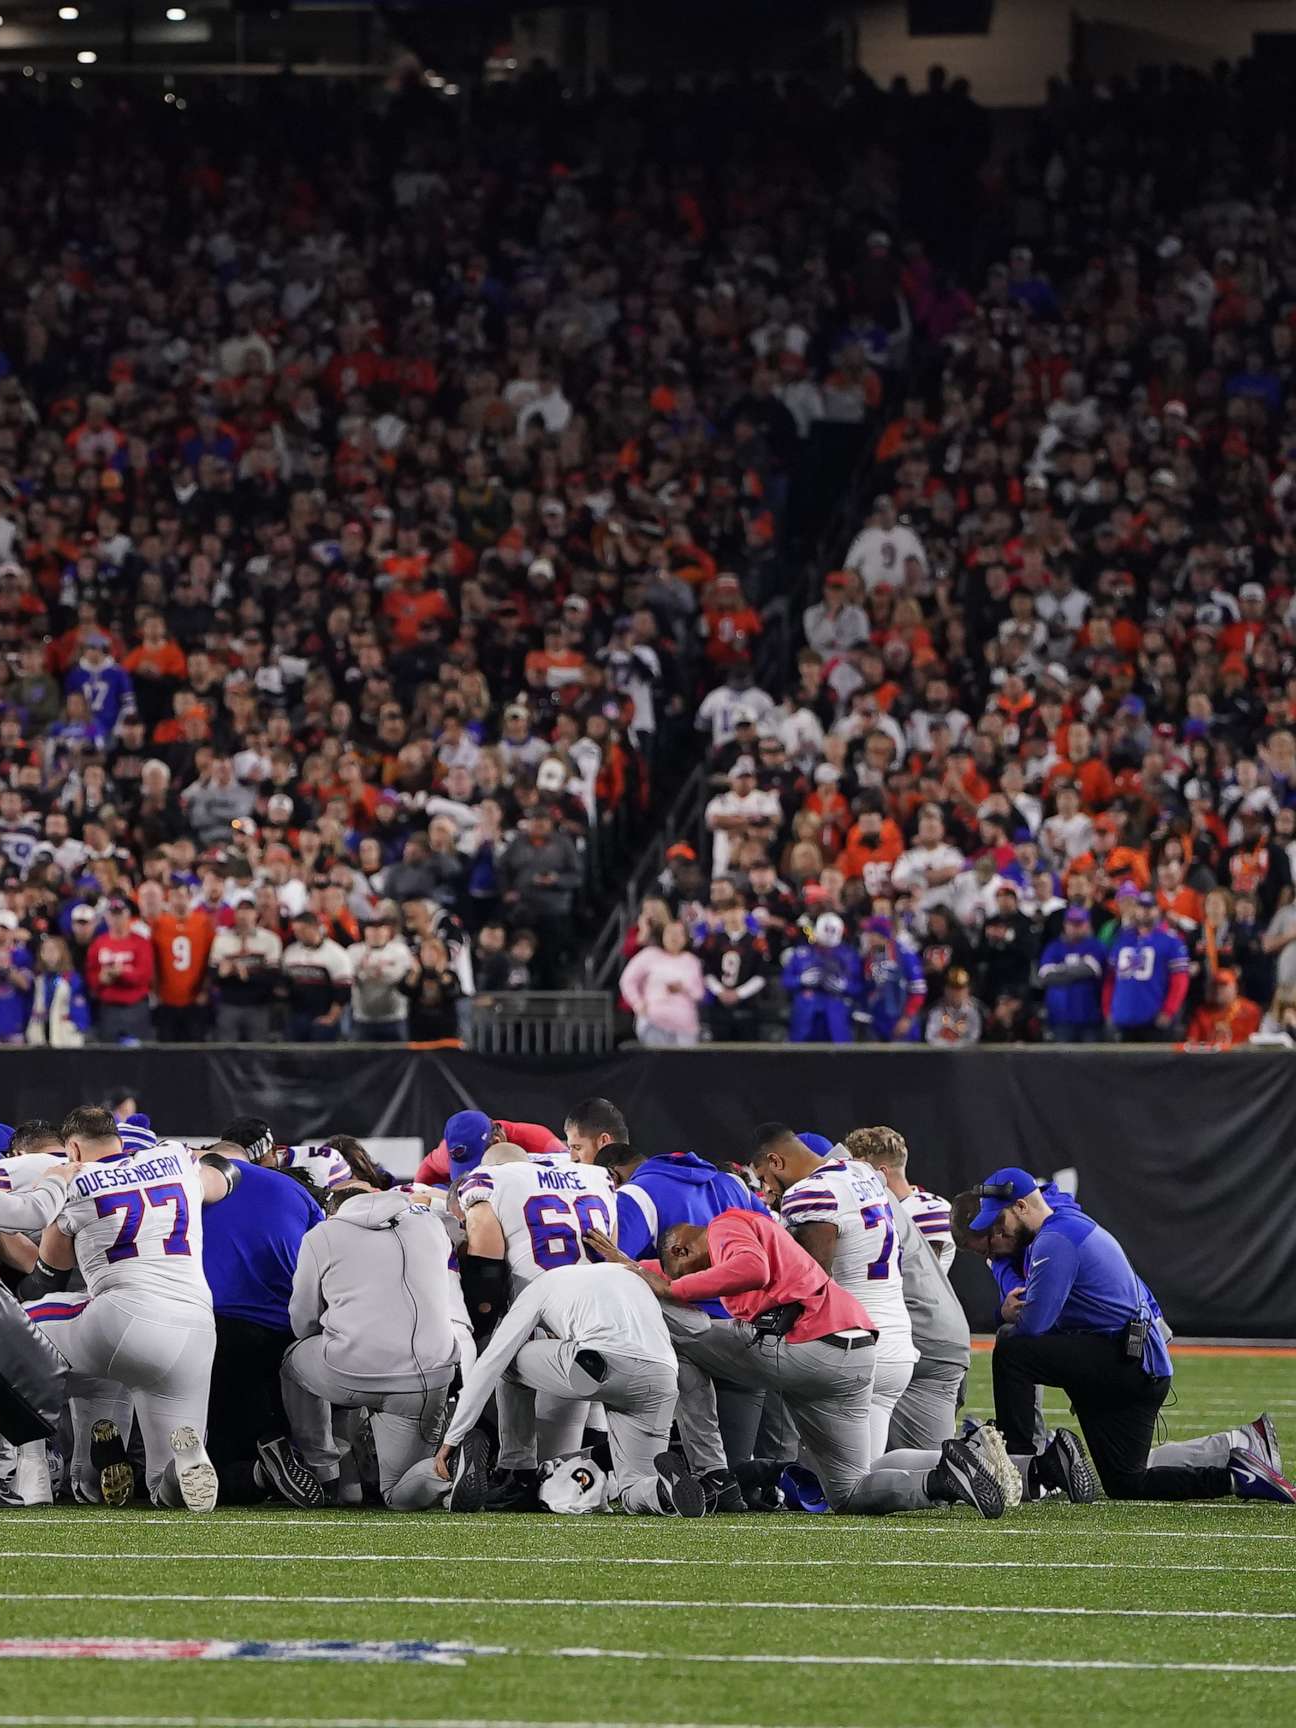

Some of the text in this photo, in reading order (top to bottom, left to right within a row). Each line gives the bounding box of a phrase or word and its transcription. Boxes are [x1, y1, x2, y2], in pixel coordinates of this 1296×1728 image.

[172, 936, 191, 971] 9
[721, 951, 740, 987] 9
[75, 1155, 183, 1197] QUESSENBERRY
[537, 1170, 587, 1190] MORSE
[95, 1183, 192, 1264] 77
[523, 1194, 611, 1272] 60
